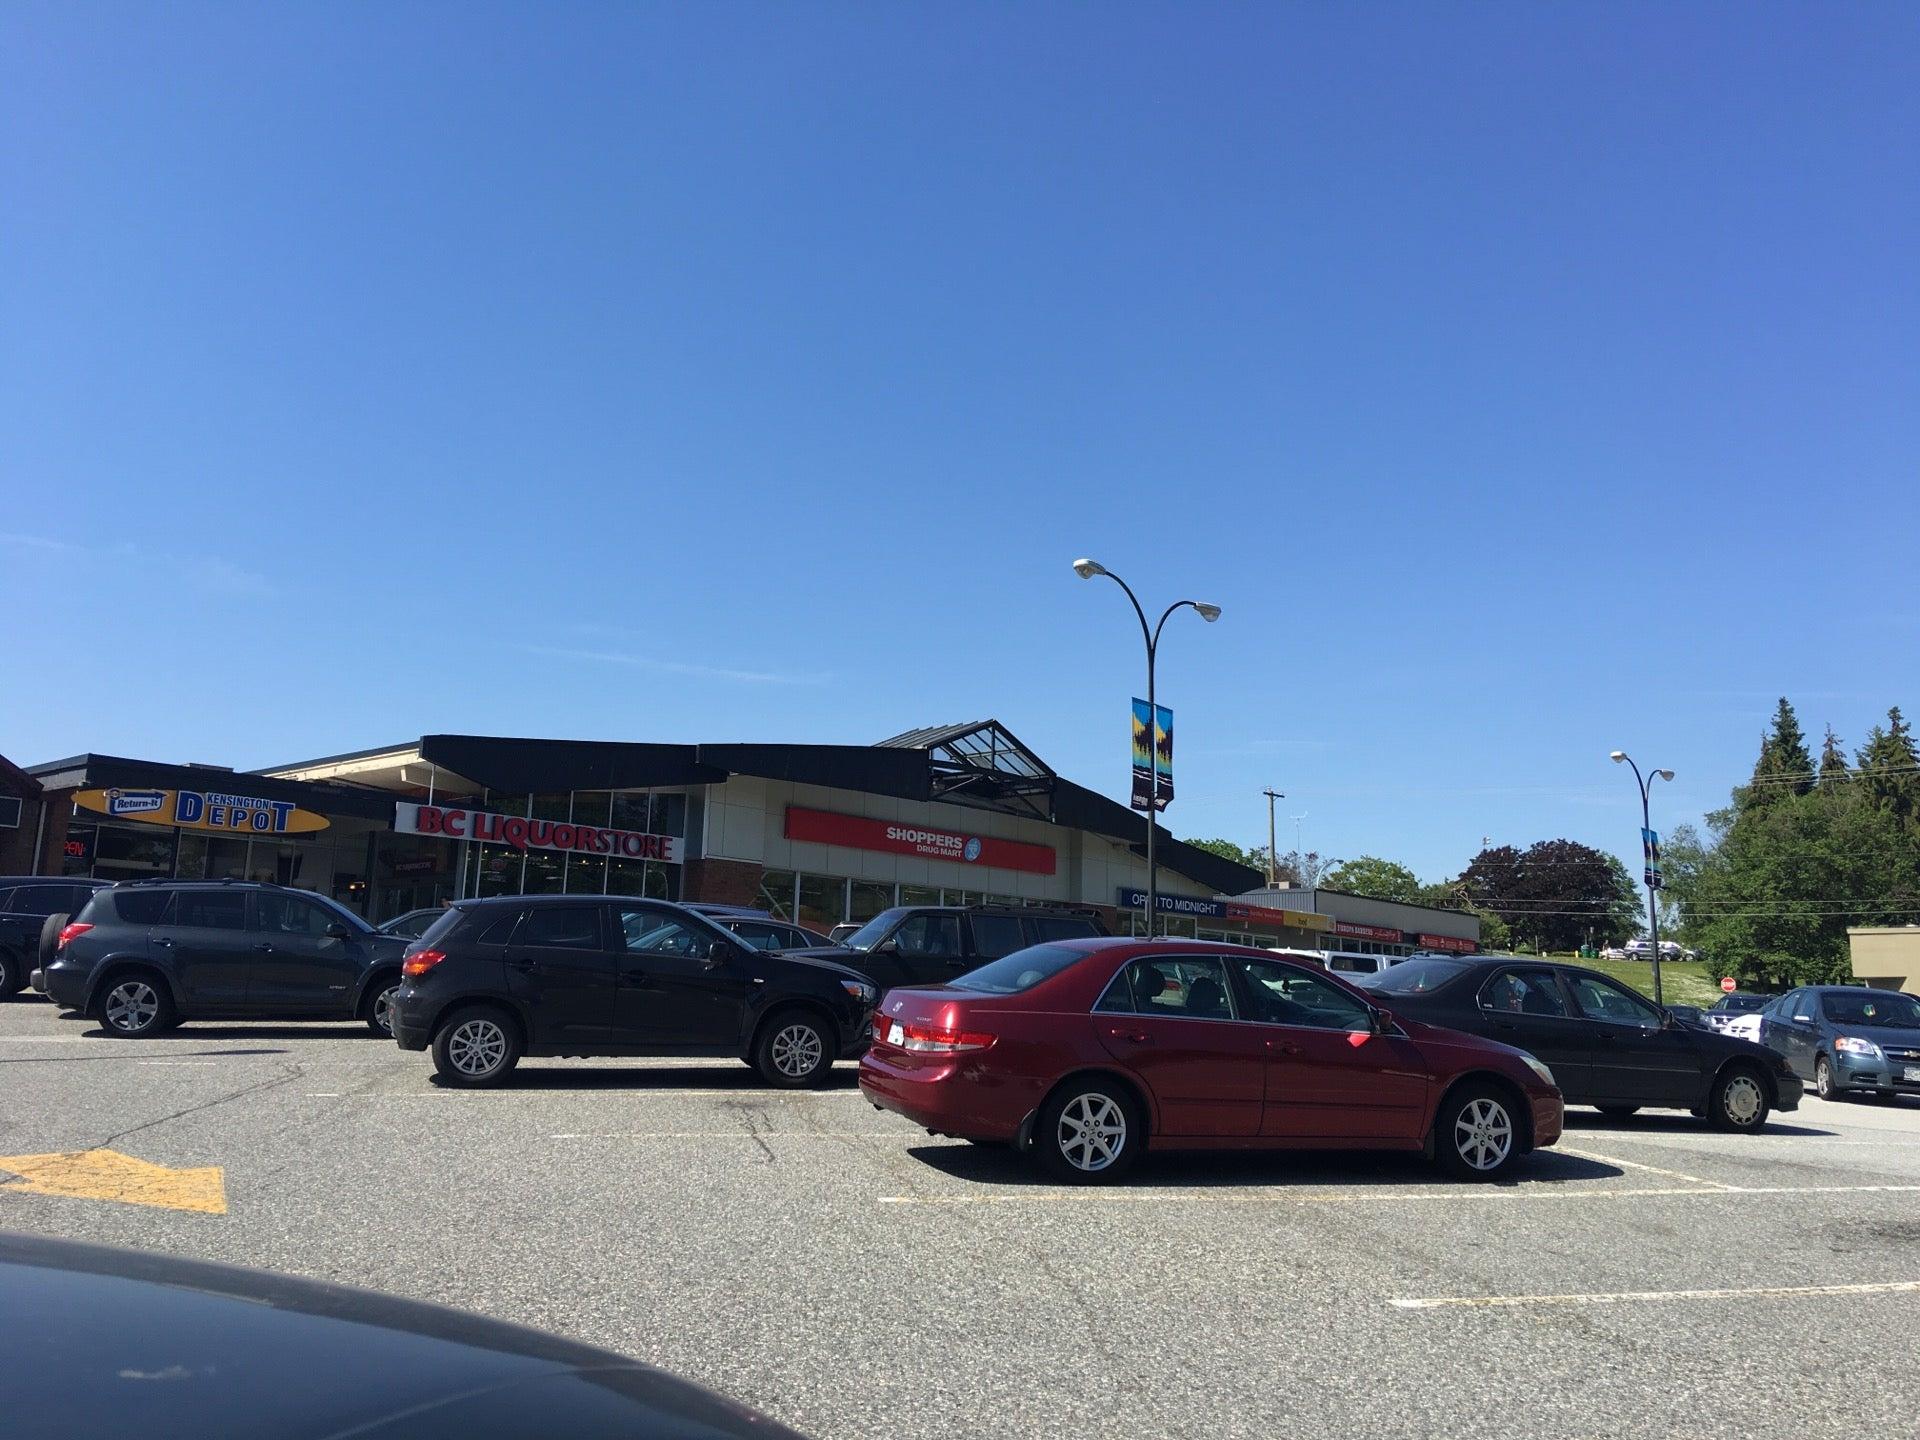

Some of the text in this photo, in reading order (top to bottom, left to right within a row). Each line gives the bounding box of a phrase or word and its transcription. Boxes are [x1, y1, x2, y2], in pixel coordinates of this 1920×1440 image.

[207, 791, 270, 810] KENSINGTON
[175, 790, 296, 833] DEPOT
[416, 805, 466, 836] BC
[63, 840, 84, 856] PEN
[886, 827, 963, 849] SHOPPERS
[916, 844, 962, 858] DRUG MART
[1132, 893, 1218, 914] OP TO MIDNIGHT
